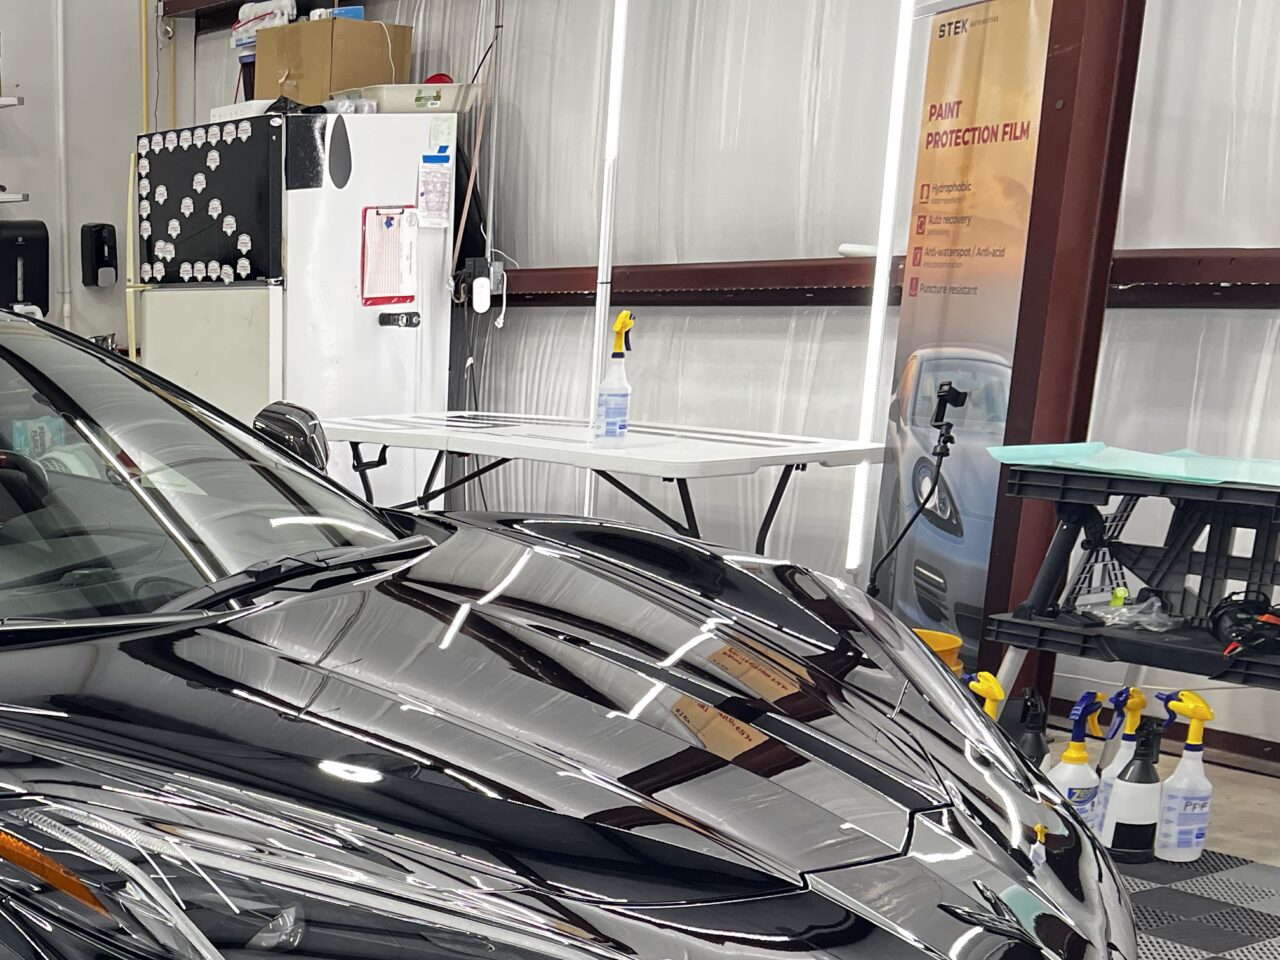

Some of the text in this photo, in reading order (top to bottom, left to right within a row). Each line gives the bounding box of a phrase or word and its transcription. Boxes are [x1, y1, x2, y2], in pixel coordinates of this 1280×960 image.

[938, 18, 969, 39] STEK
[929, 100, 962, 121] PAINT
[925, 121, 1030, 150] PROTECTION FILM
[931, 181, 972, 196] Hydrophobic
[928, 215, 972, 227] Auto recovery
[924, 246, 971, 259] Anti-waterspot
[976, 246, 1005, 258] Anti-acid
[920, 283, 978, 295] Puncture resistant
